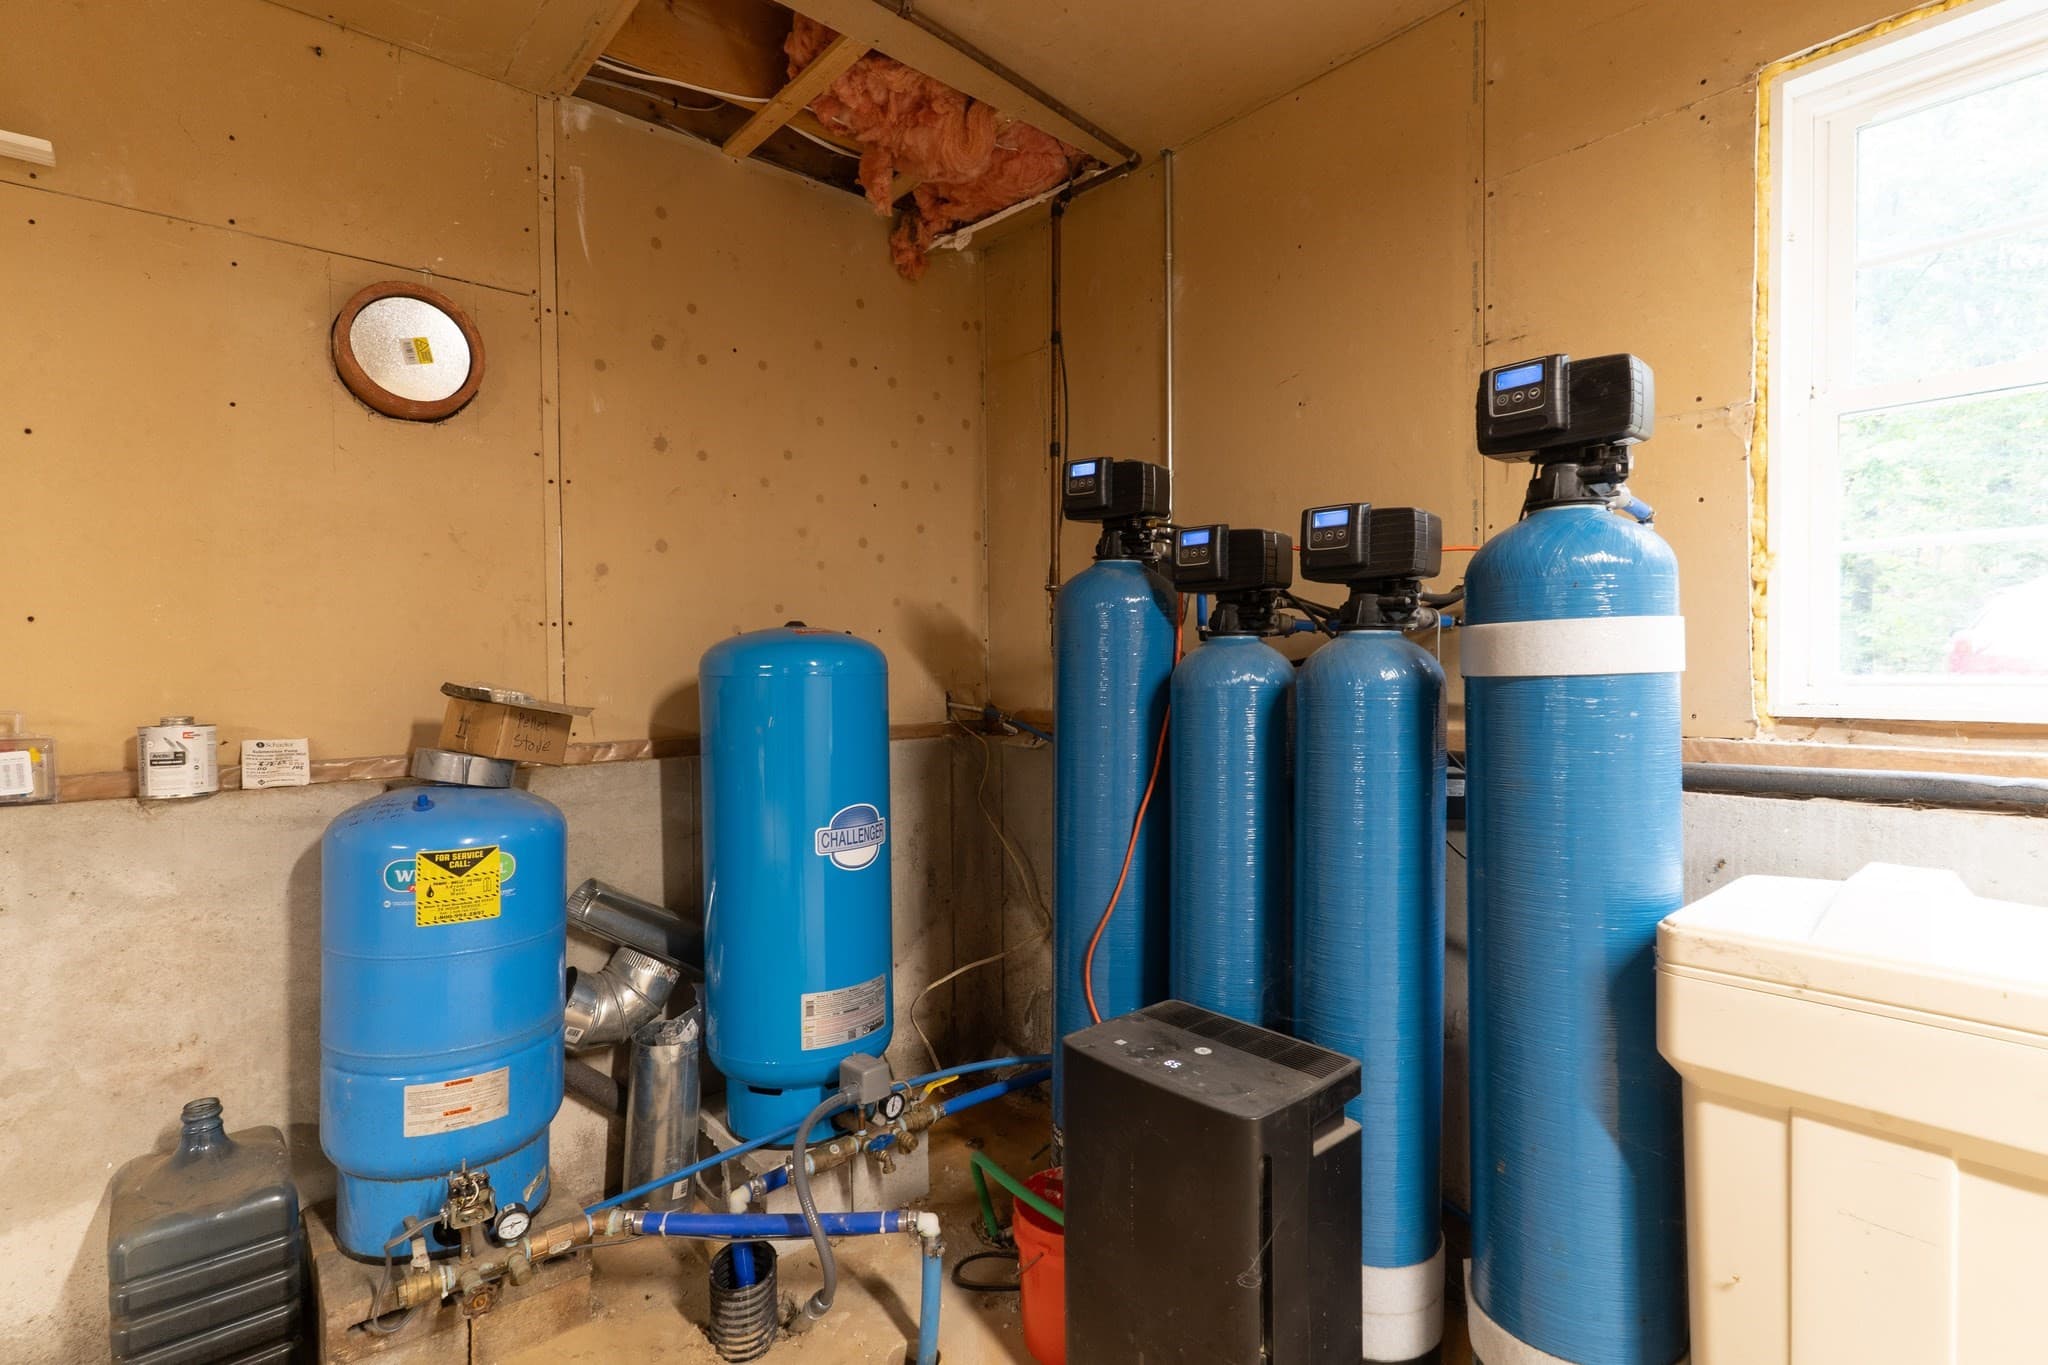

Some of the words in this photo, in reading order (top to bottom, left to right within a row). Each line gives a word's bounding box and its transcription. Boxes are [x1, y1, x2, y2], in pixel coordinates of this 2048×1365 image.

[517, 712, 552, 732] Pellet
[513, 733, 552, 754] Stove
[821, 823, 884, 849] CHALLENGER
[435, 853, 450, 862] FOR
[452, 850, 484, 861] SERVICE
[449, 860, 471, 869] CALL:
